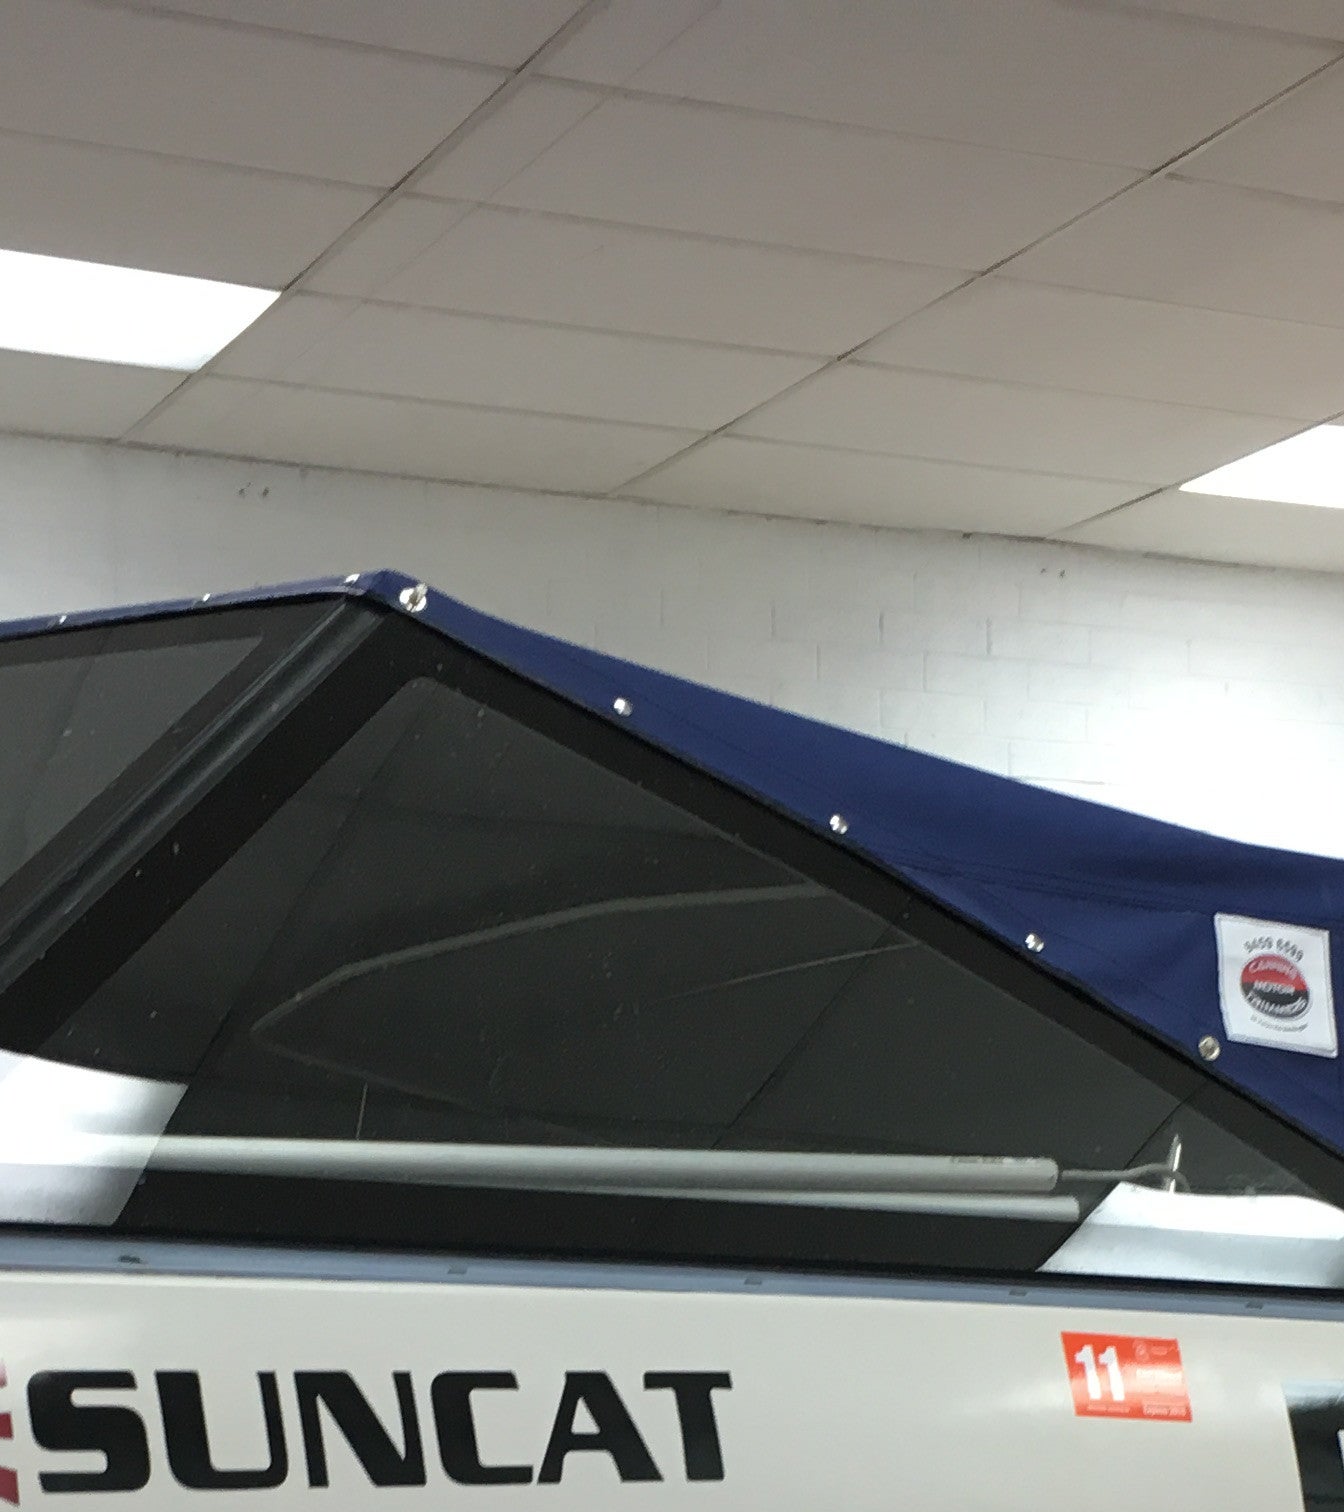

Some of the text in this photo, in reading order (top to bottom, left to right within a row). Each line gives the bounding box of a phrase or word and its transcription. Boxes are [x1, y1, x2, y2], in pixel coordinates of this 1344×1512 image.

[1254, 981, 1296, 996] MOTOR
[1074, 1344, 1125, 1401] 11
[27, 1368, 732, 1492] SUNCAT
